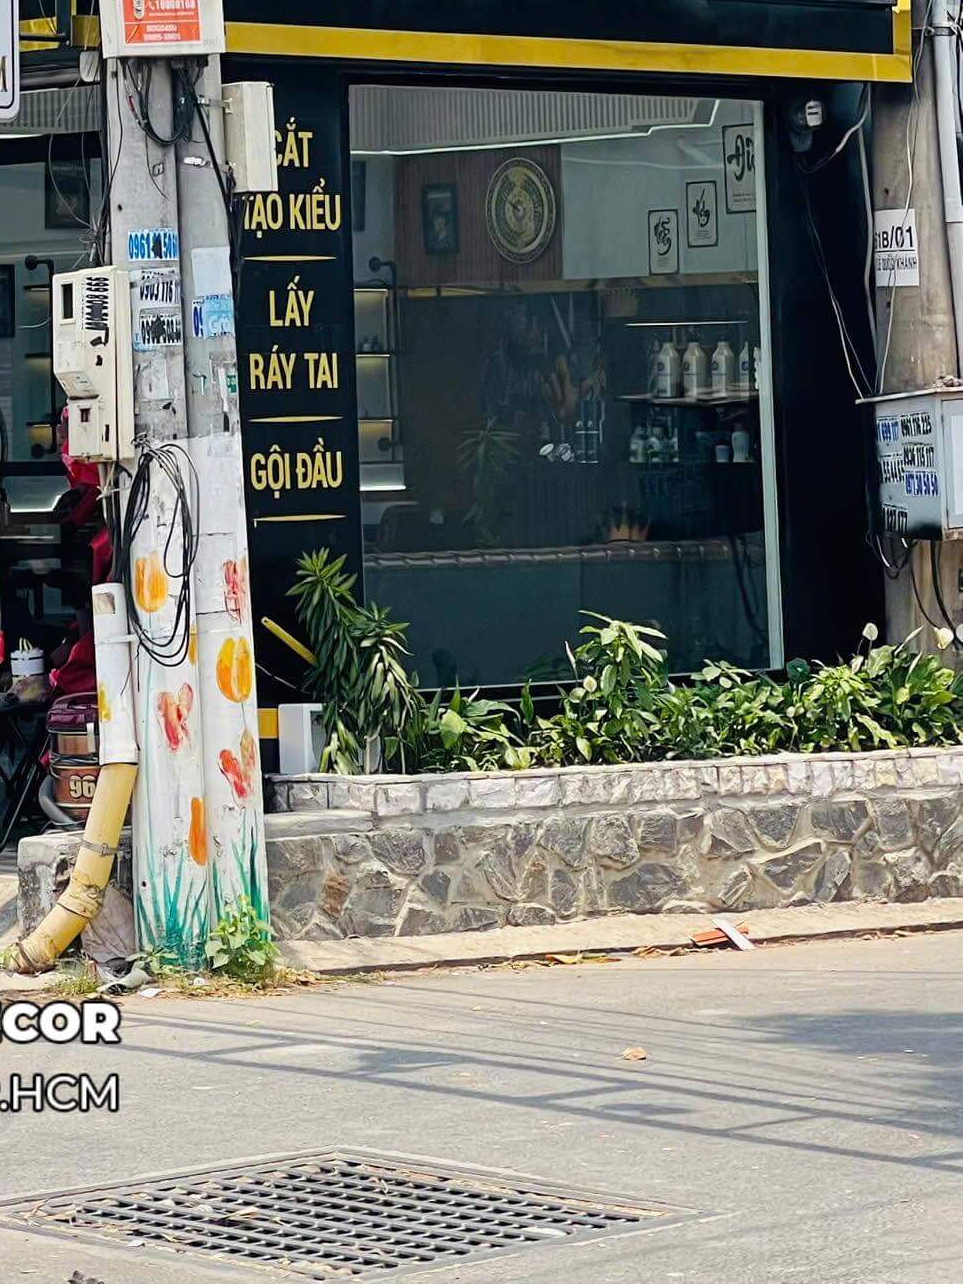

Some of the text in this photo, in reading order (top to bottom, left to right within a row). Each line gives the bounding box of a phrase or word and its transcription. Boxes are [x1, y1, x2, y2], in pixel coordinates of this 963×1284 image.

[289, 178, 341, 230] KIỂU
[269, 276, 315, 327] LẤY
[249, 344, 339, 390] RÁY TAI
[250, 437, 343, 499] GỘI ĐẦU
